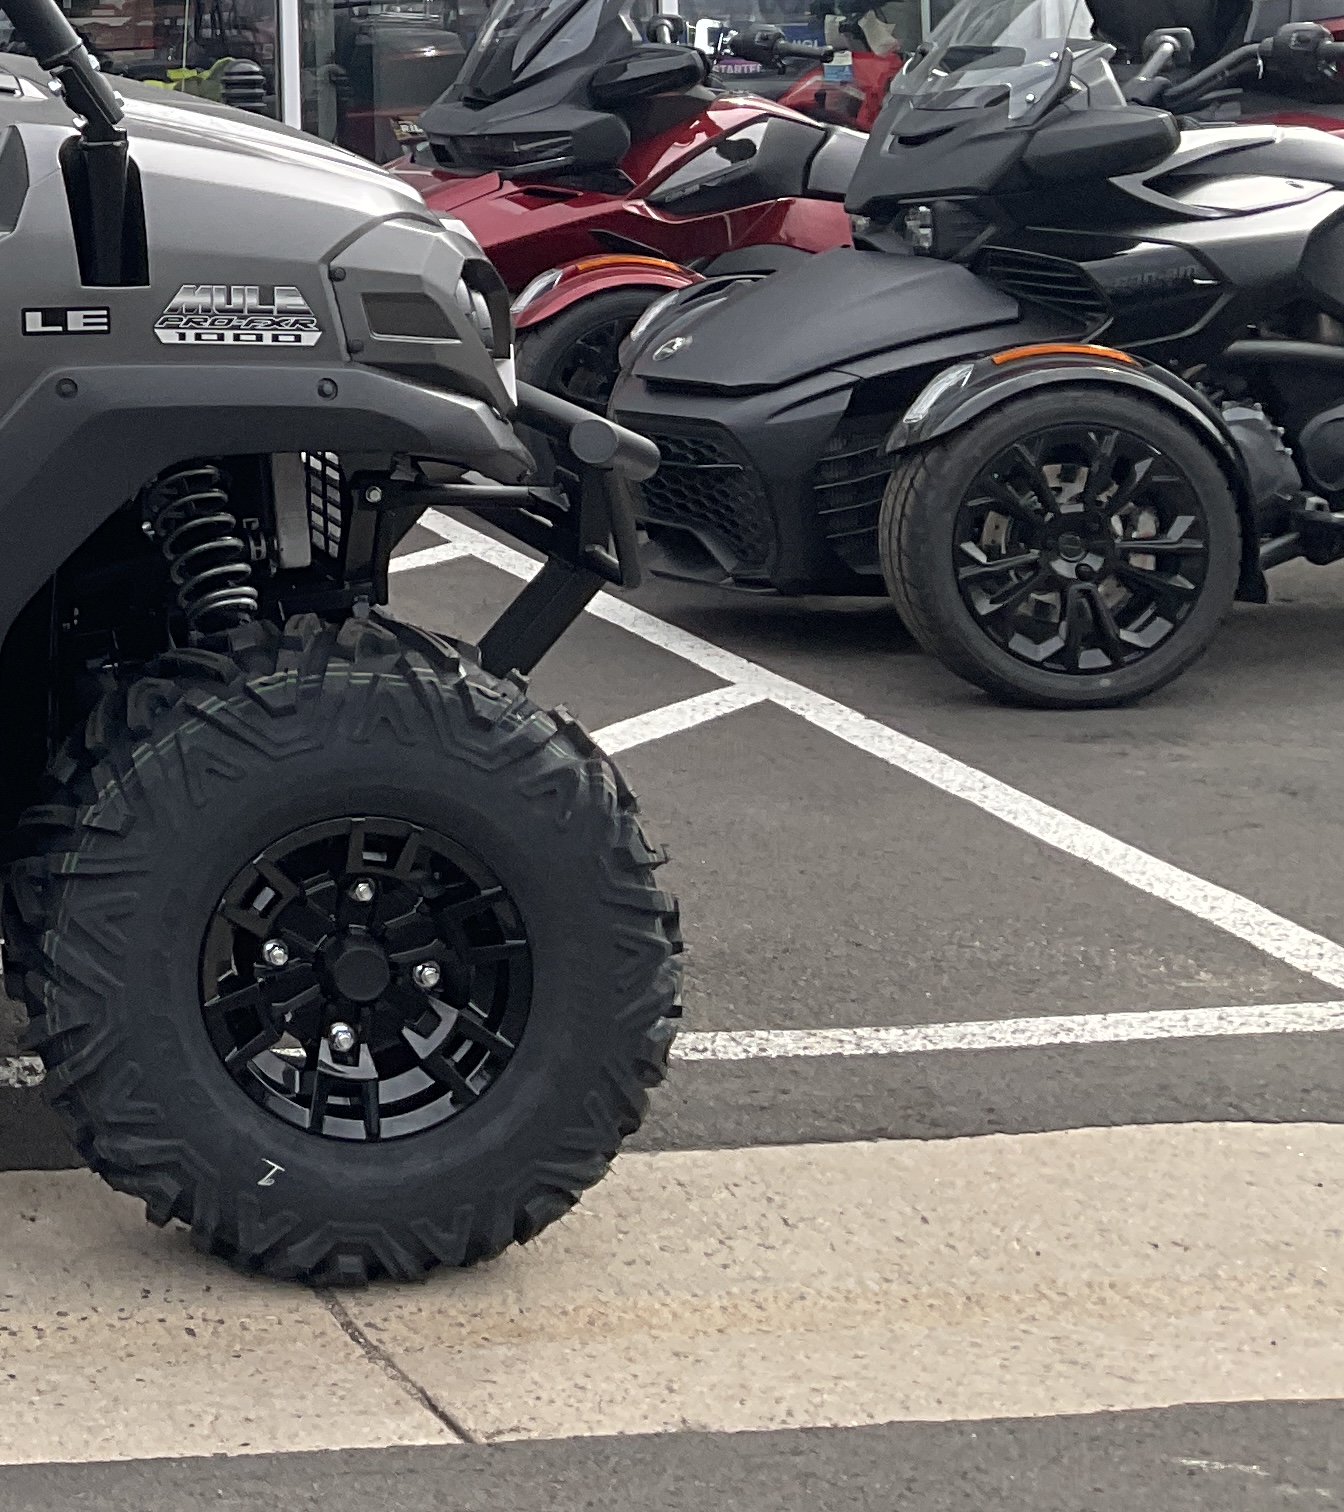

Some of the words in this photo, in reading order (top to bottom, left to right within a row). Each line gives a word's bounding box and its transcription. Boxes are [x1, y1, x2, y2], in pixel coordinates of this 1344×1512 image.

[163, 284, 314, 316] MULE
[25, 309, 108, 332] LE
[154, 315, 320, 331] PRO-FXR
[176, 331, 302, 344] 1000
